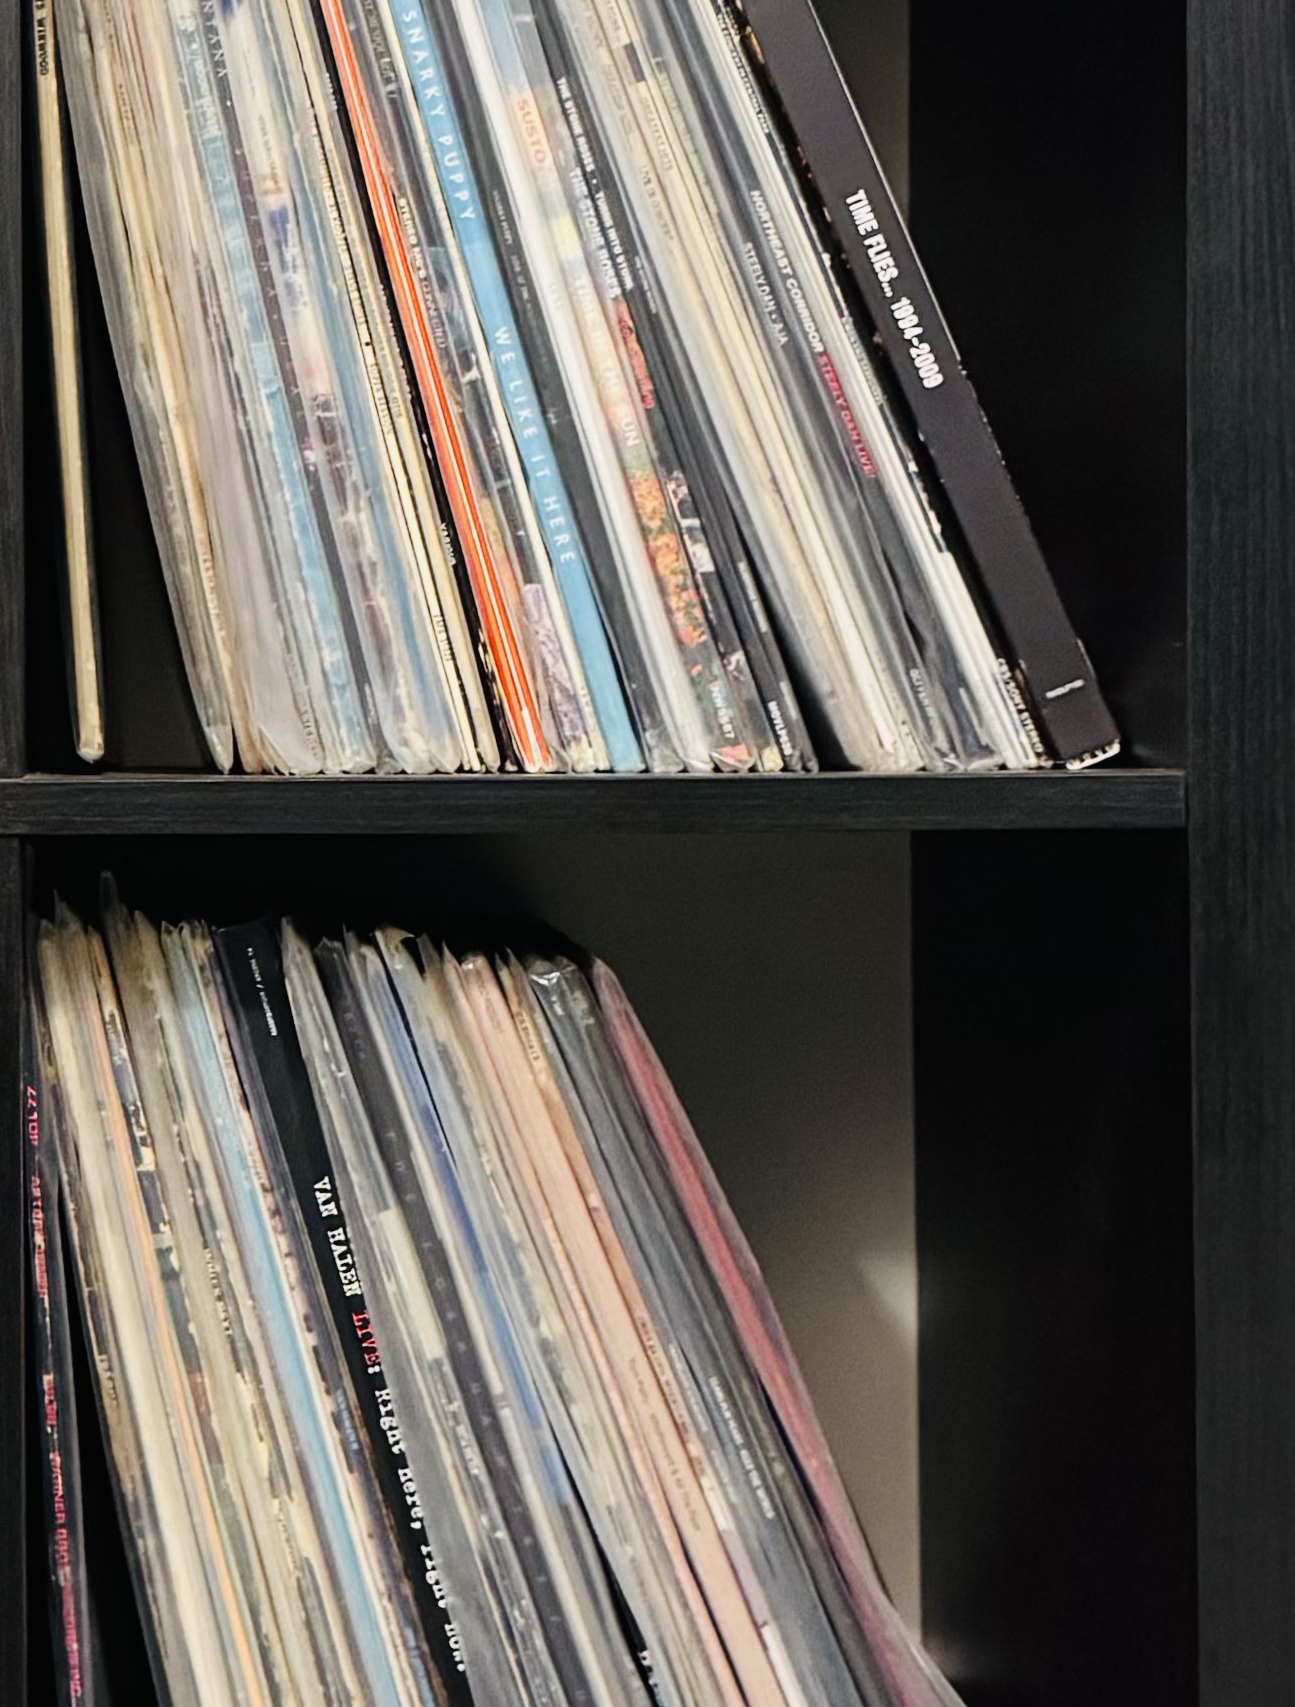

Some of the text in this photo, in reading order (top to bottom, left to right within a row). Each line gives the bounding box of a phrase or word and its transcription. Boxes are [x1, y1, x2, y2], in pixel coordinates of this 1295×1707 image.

[36, 17, 50, 75] WINWOOD
[401, 8, 477, 223] SNARKY PUPPY
[516, 95, 549, 166] SUSTO
[556, 75, 636, 291] THE STONE ROSES TURNS INTO STONE
[568, 166, 623, 299] THE STONE ROSES
[741, 240, 791, 346] STEELY DAN AJA
[748, 188, 794, 277] NORTHEAST
[784, 276, 826, 355] CORRIDOR
[816, 353, 849, 408] STEELY
[839, 408, 862, 442] DAN
[844, 187, 882, 237] TIME
[863, 232, 908, 299] FLIES...
[889, 294, 946, 392] 1994-2009
[492, 326, 576, 564] WE LIKE IT HERE
[995, 656, 1045, 755] CBS/SONY STEREO
[27, 1110, 39, 1146] TOP
[311, 1175, 339, 1218] VAN
[326, 1227, 363, 1298] HALEN
[350, 1308, 386, 1376] LIVE:
[371, 1387, 408, 1457] Right
